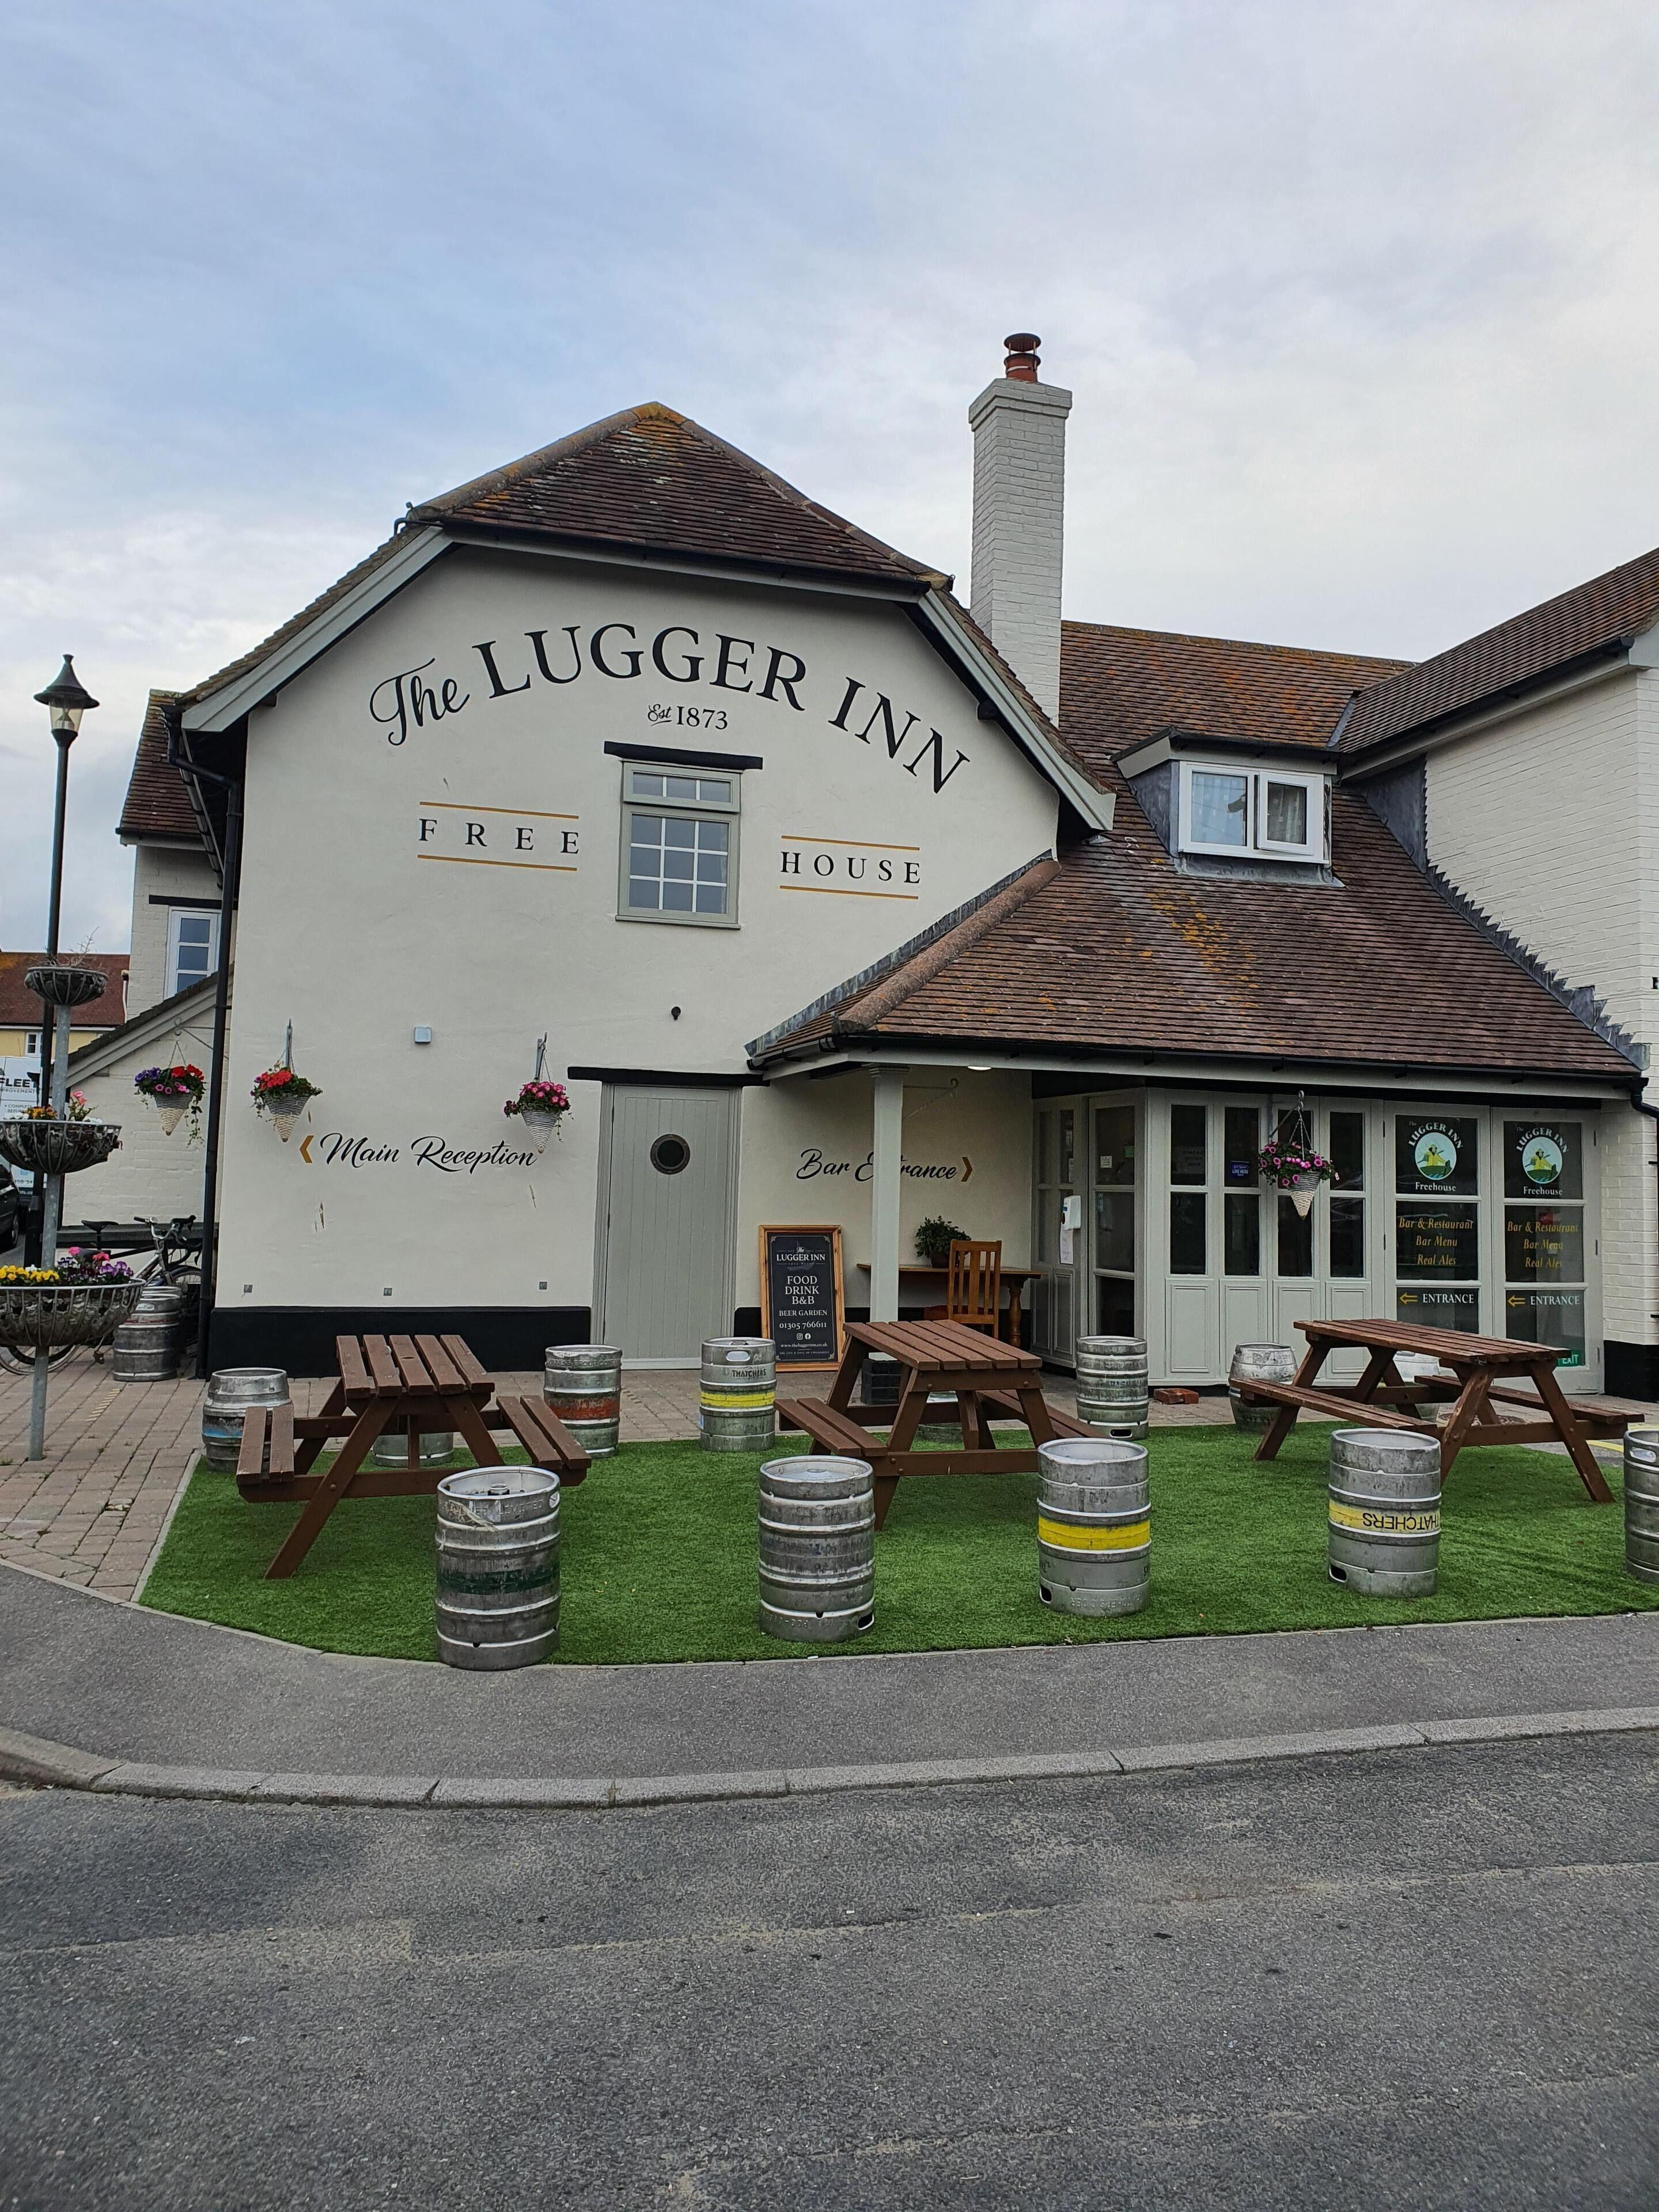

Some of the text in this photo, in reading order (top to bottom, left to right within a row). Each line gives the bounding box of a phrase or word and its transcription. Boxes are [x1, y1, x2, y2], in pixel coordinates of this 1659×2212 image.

[369, 623, 970, 794] The LUGGER INN
[647, 703, 728, 730] Est 1873
[418, 819, 579, 855] FREE
[780, 851, 921, 885] HOUSE
[1408, 1122, 1446, 1146] LUGGER
[1448, 1129, 1463, 1149] INN
[1516, 1127, 1552, 1152] LUGGER
[1554, 1134, 1569, 1153] INN
[320, 1132, 536, 1174] Main Reception
[796, 1149, 957, 1181] Bar Erance
[1415, 1182, 1457, 1191] Freehouse
[1523, 1186, 1563, 1195] Freehouse
[1399, 1217, 1474, 1229] Bar & Restaurant
[1508, 1221, 1578, 1233] Bar & Restaurant
[1415, 1235, 1457, 1246] Bar Menu
[1524, 1239, 1563, 1249] Bar Menu
[1417, 1254, 1456, 1265] Real Ales
[1525, 1257, 1562, 1267] Real Ales
[787, 1275, 817, 1285] FOOD
[785, 1286, 820, 1294] DRINK
[792, 1296, 815, 1304] B&B
[1423, 1294, 1474, 1304] ENTRANCE
[1531, 1296, 1580, 1305] ENTRANCE
[802, 1321, 827, 1330] 766611
[732, 1368, 767, 1378] THATCHERS
[1362, 1513, 1439, 1530] THATCHERS
